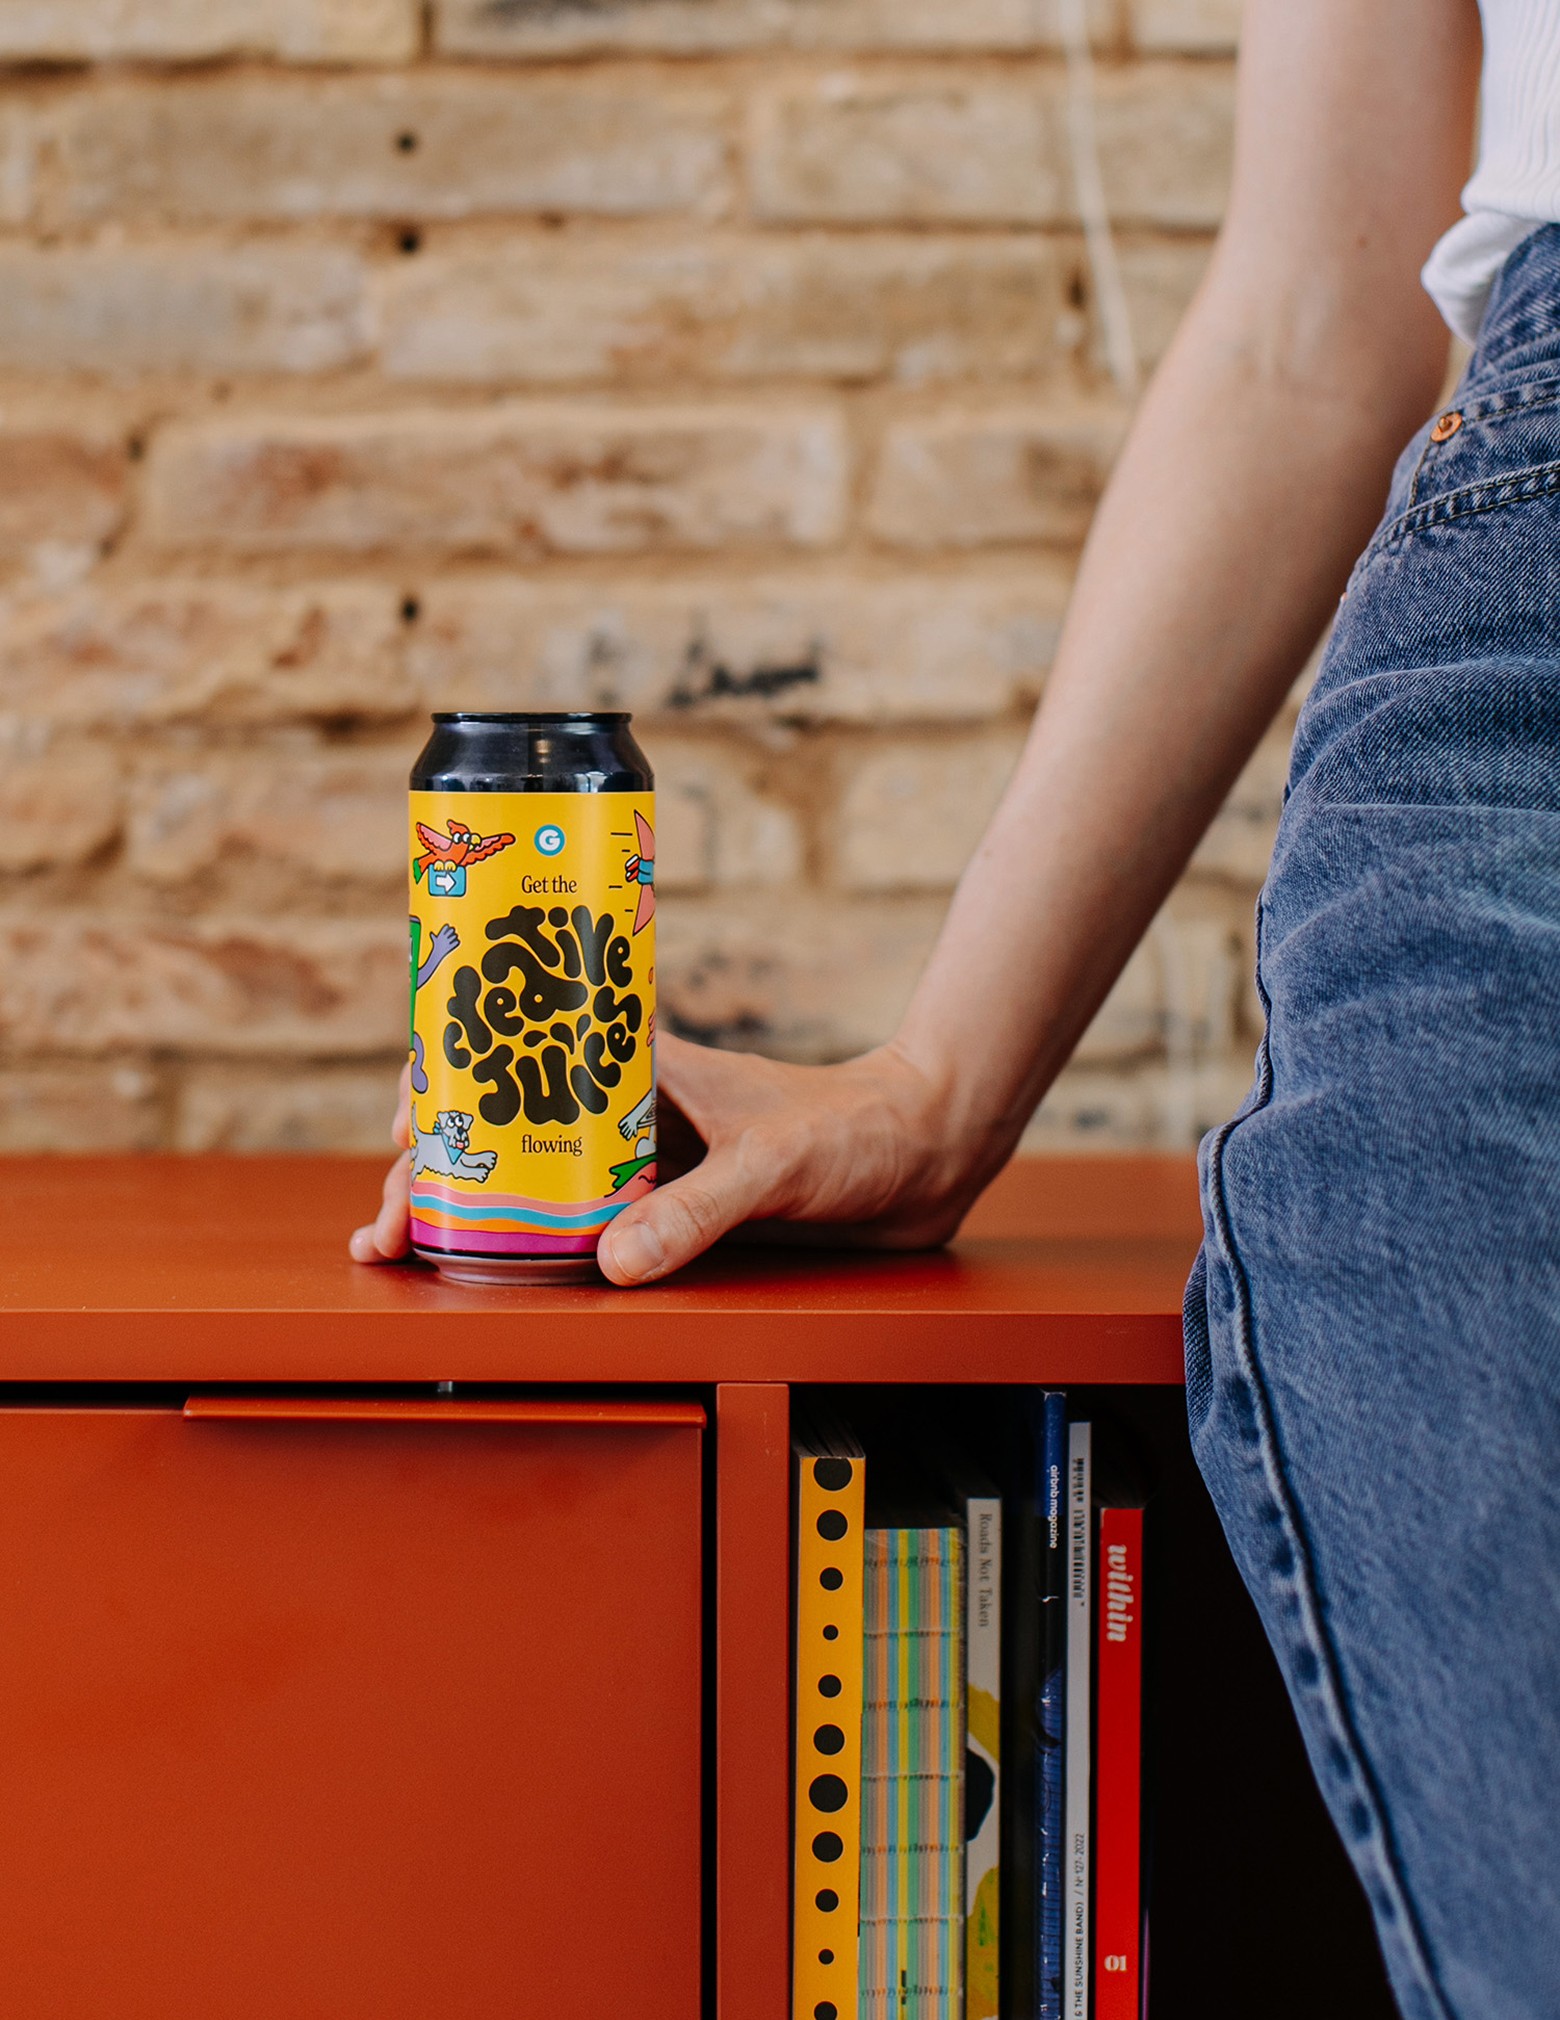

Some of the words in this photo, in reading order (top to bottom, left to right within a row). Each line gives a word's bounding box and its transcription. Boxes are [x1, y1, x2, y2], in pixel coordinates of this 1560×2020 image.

[538, 829, 560, 853] G
[521, 875, 549, 894] Get
[552, 875, 577, 894] the
[521, 1135, 583, 1157] flowing
[1049, 1464, 1061, 1498] airbnb
[979, 1512, 993, 1554] Roads
[1047, 1498, 1060, 1549] magazine
[979, 1558, 993, 1582] Not
[977, 1587, 993, 1628] Taken
[1106, 1544, 1135, 1642] within
[1075, 1902, 1084, 1935] BAND)
[1074, 1938, 1084, 1987] SUNSHINE
[1104, 1955, 1128, 1972] 01
[1074, 1990, 1084, 2008] THE
